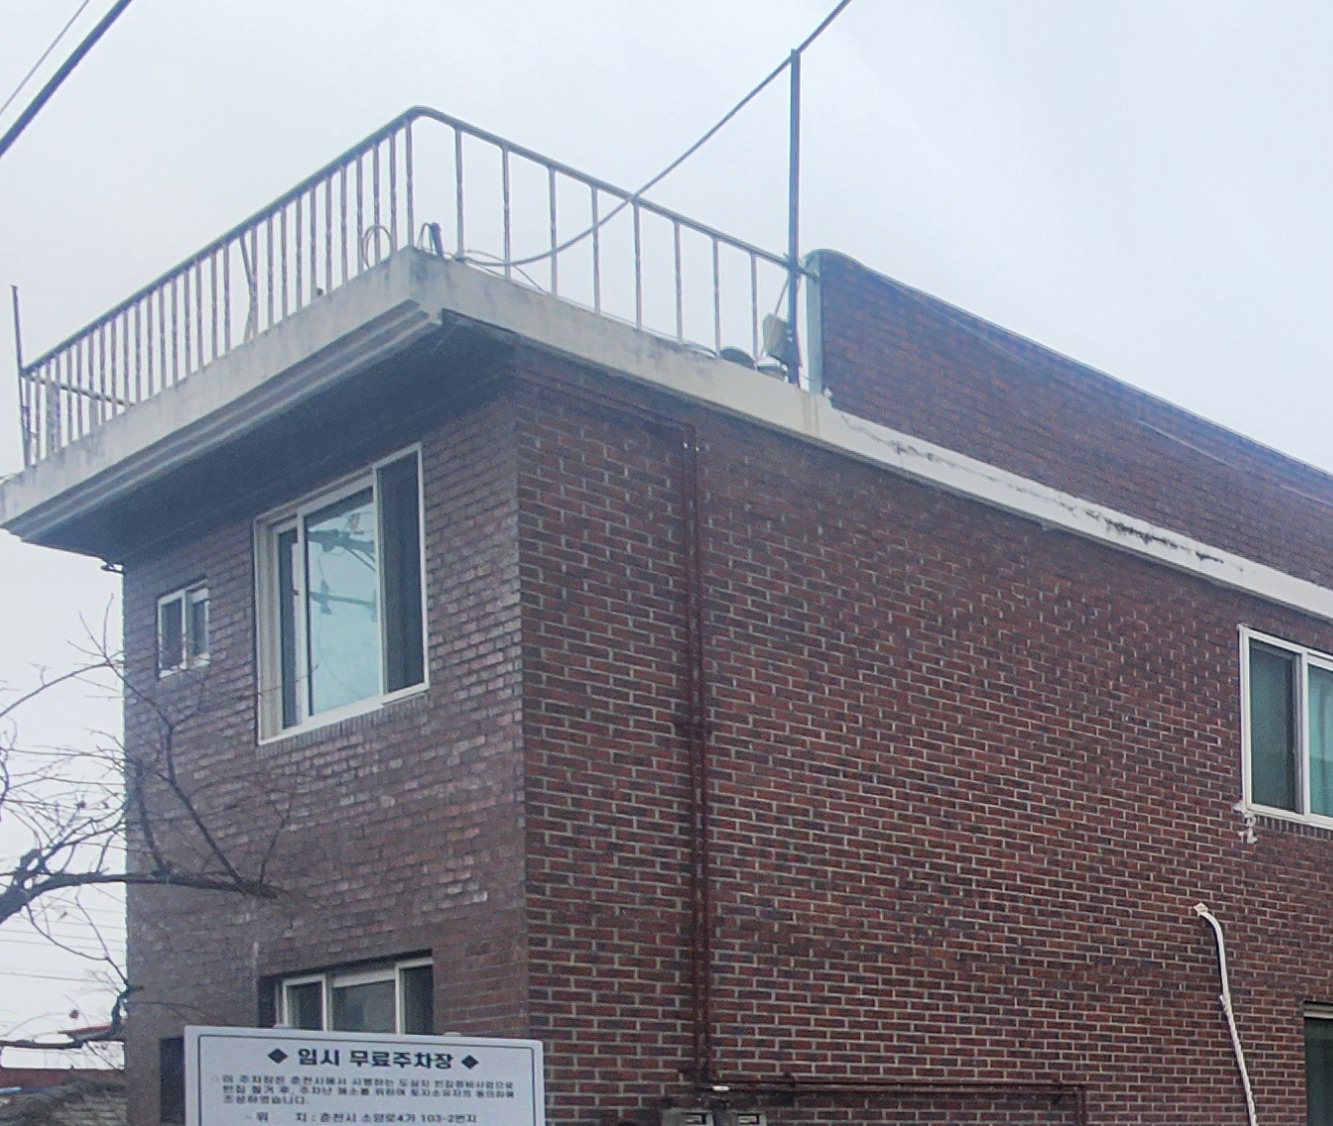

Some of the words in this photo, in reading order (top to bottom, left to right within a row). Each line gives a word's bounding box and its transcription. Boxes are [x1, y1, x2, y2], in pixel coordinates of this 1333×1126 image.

[298, 1048, 339, 1066] 임시
[349, 1049, 453, 1069] 무료주차장
[256, 1112, 268, 1122] 위
[296, 1112, 306, 1122] 치
[320, 1112, 356, 1122] 춘천시
[360, 1113, 415, 1123] 소양로4가
[420, 1113, 476, 1123] 103-2번지
